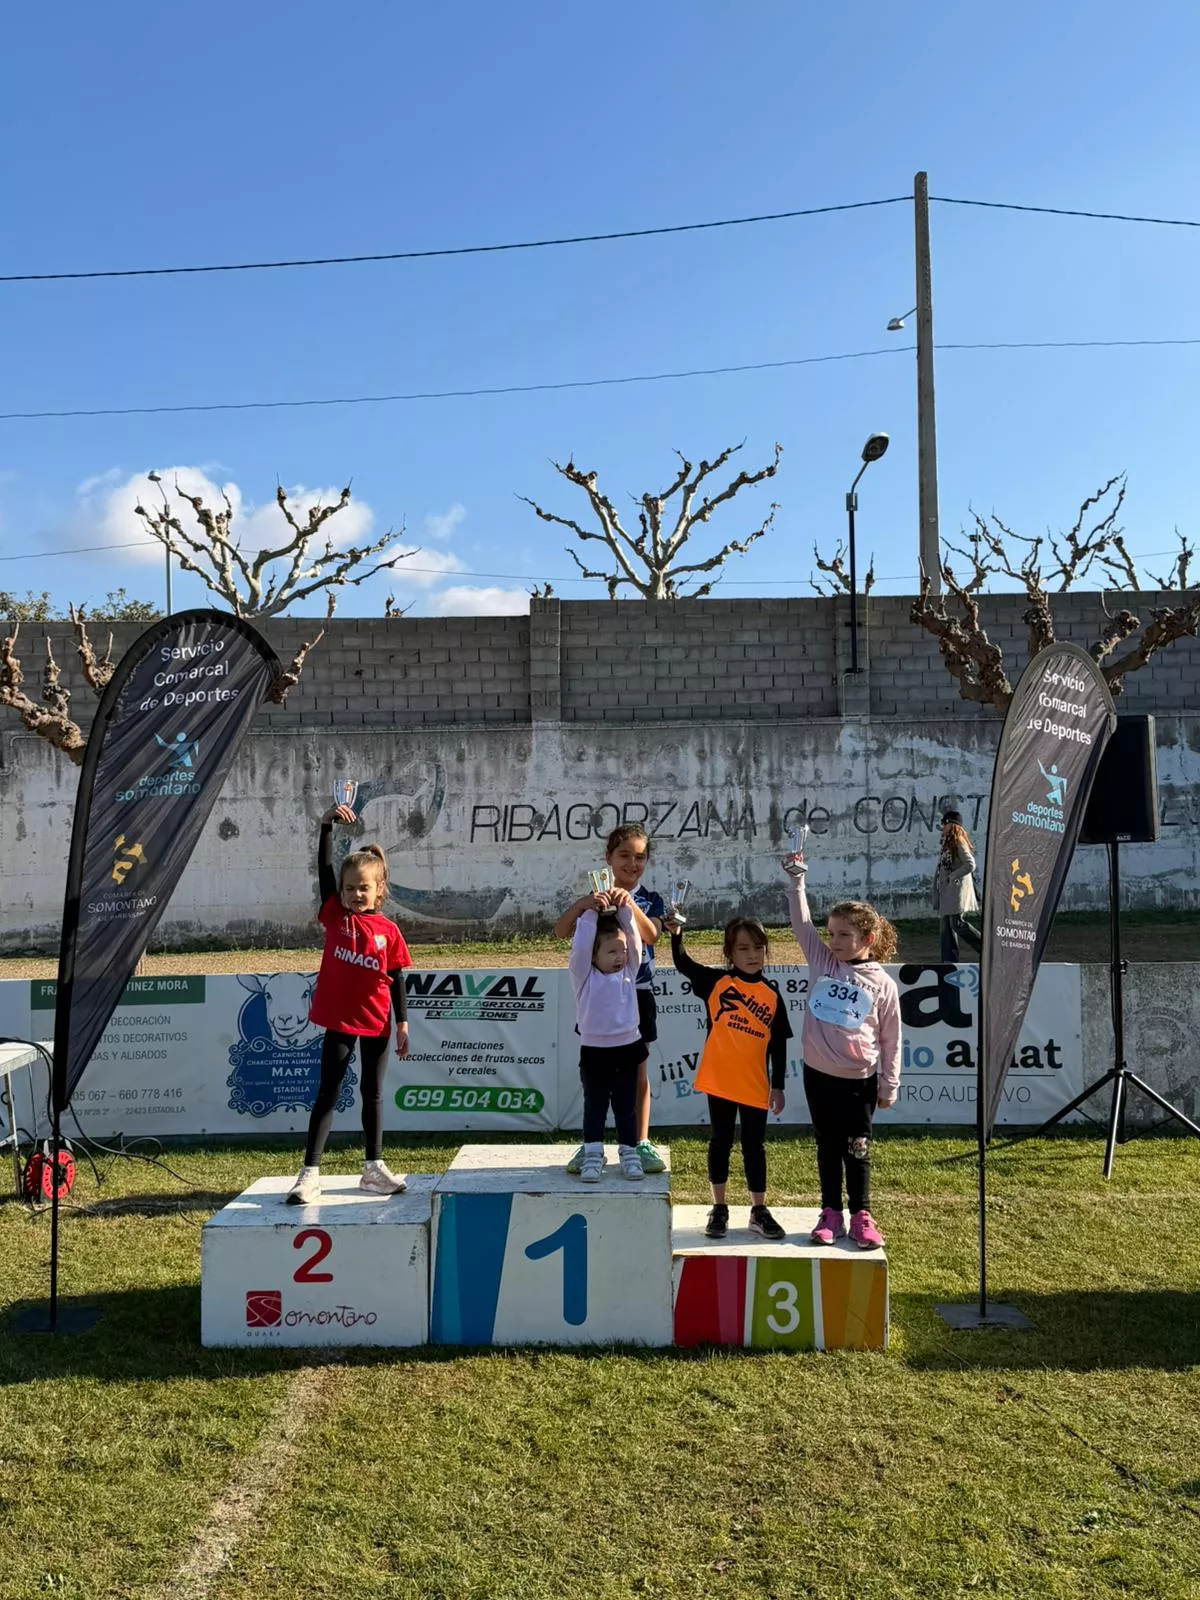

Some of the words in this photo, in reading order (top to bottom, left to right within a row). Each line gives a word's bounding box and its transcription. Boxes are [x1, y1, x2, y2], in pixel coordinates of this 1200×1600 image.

[161, 640, 224, 662] Servicio
[154, 661, 229, 687] Comarcal
[1043, 669, 1085, 692] Servicio
[140, 697, 159, 711] de
[164, 687, 240, 706] Deportes
[1038, 692, 1087, 718] Comarcal
[1044, 719, 1092, 745] Deportes
[139, 770, 195, 787] deportes
[115, 782, 200, 802] somontano
[783, 798, 830, 835] de
[1027, 801, 1063, 819] deportes
[1012, 811, 1065, 834] somontano
[88, 896, 157, 914] SOMONTANO
[157, 979, 188, 991] MORA
[405, 974, 545, 998] NAVAL
[828, 984, 859, 1004] 334
[406, 1000, 475, 1008] ERVICIOS
[476, 1001, 545, 1009] AGRICOLAS
[111, 1013, 171, 1026] DECORACIÓN
[426, 1010, 519, 1019] EXCAVACIONES
[729, 1014, 749, 1024] club
[123, 1031, 188, 1043] DECORATIVOS
[727, 1021, 766, 1039] atletismo
[441, 1040, 504, 1050] Plantaciones
[112, 1050, 120, 1060] Y
[121, 1049, 168, 1060] ALISADOS
[471, 1053, 483, 1063] de
[485, 1053, 515, 1064] frutos
[518, 1056, 545, 1065] secos
[271, 1067, 311, 1077] MARY
[448, 1067, 453, 1076] y
[456, 1066, 497, 1075] cereales
[88, 1090, 107, 1101] 067
[119, 1089, 138, 1100] 660
[141, 1088, 160, 1099] 778
[163, 1087, 182, 1098] 416
[404, 1089, 445, 1107] 699
[450, 1090, 491, 1108] 504
[497, 1091, 537, 1109] 034
[148, 1105, 186, 1115] ESTADILLA
[293, 1228, 334, 1283] 2
[524, 1213, 588, 1326] 1
[766, 1280, 800, 1334] 3
